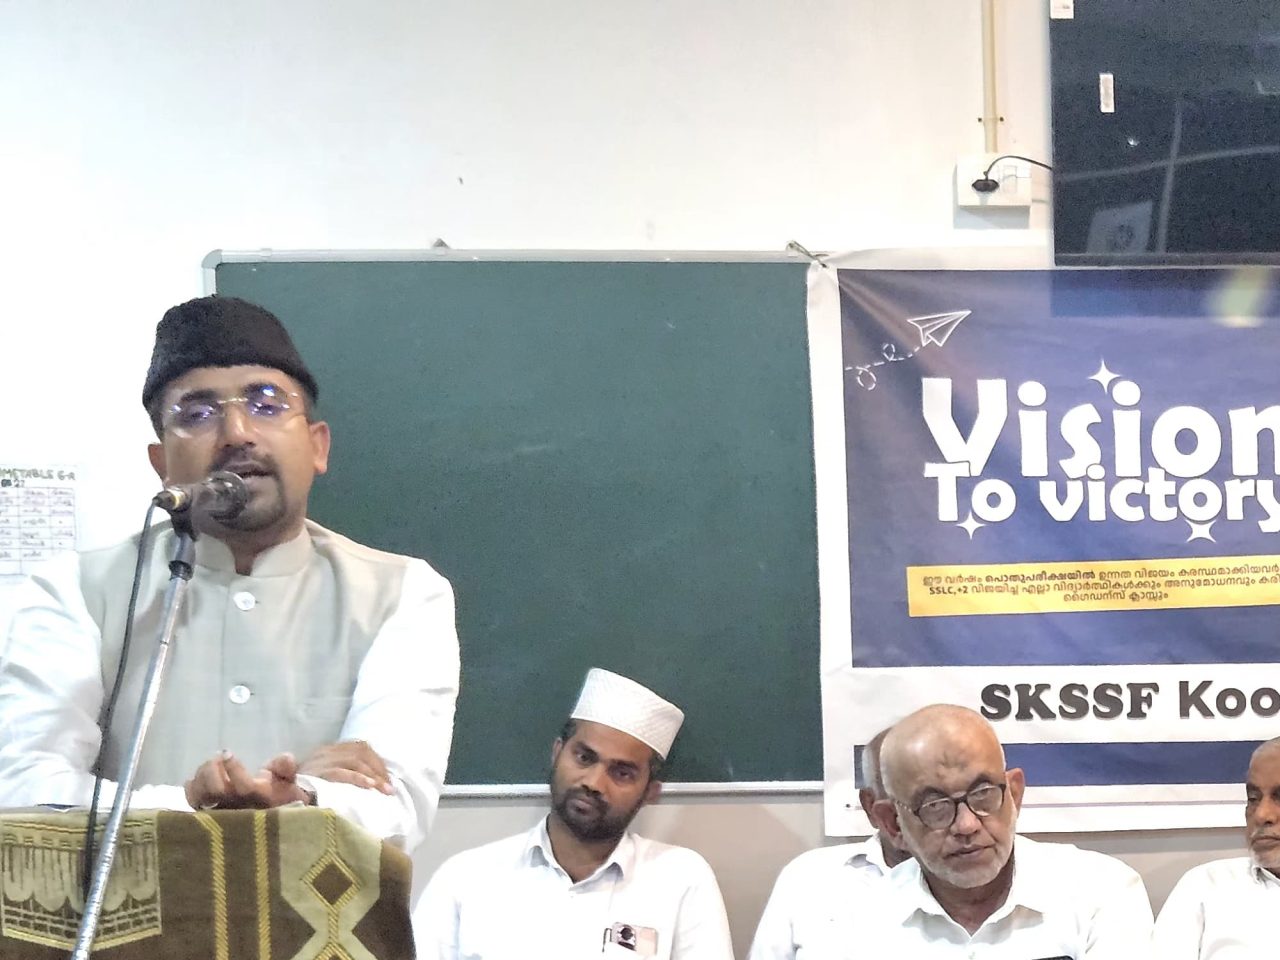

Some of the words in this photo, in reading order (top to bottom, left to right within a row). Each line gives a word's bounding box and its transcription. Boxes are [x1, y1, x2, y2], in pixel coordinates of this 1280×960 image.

[923, 462, 1017, 522] To
[923, 576, 942, 587] ഈ
[979, 682, 1159, 721] SKSSF
